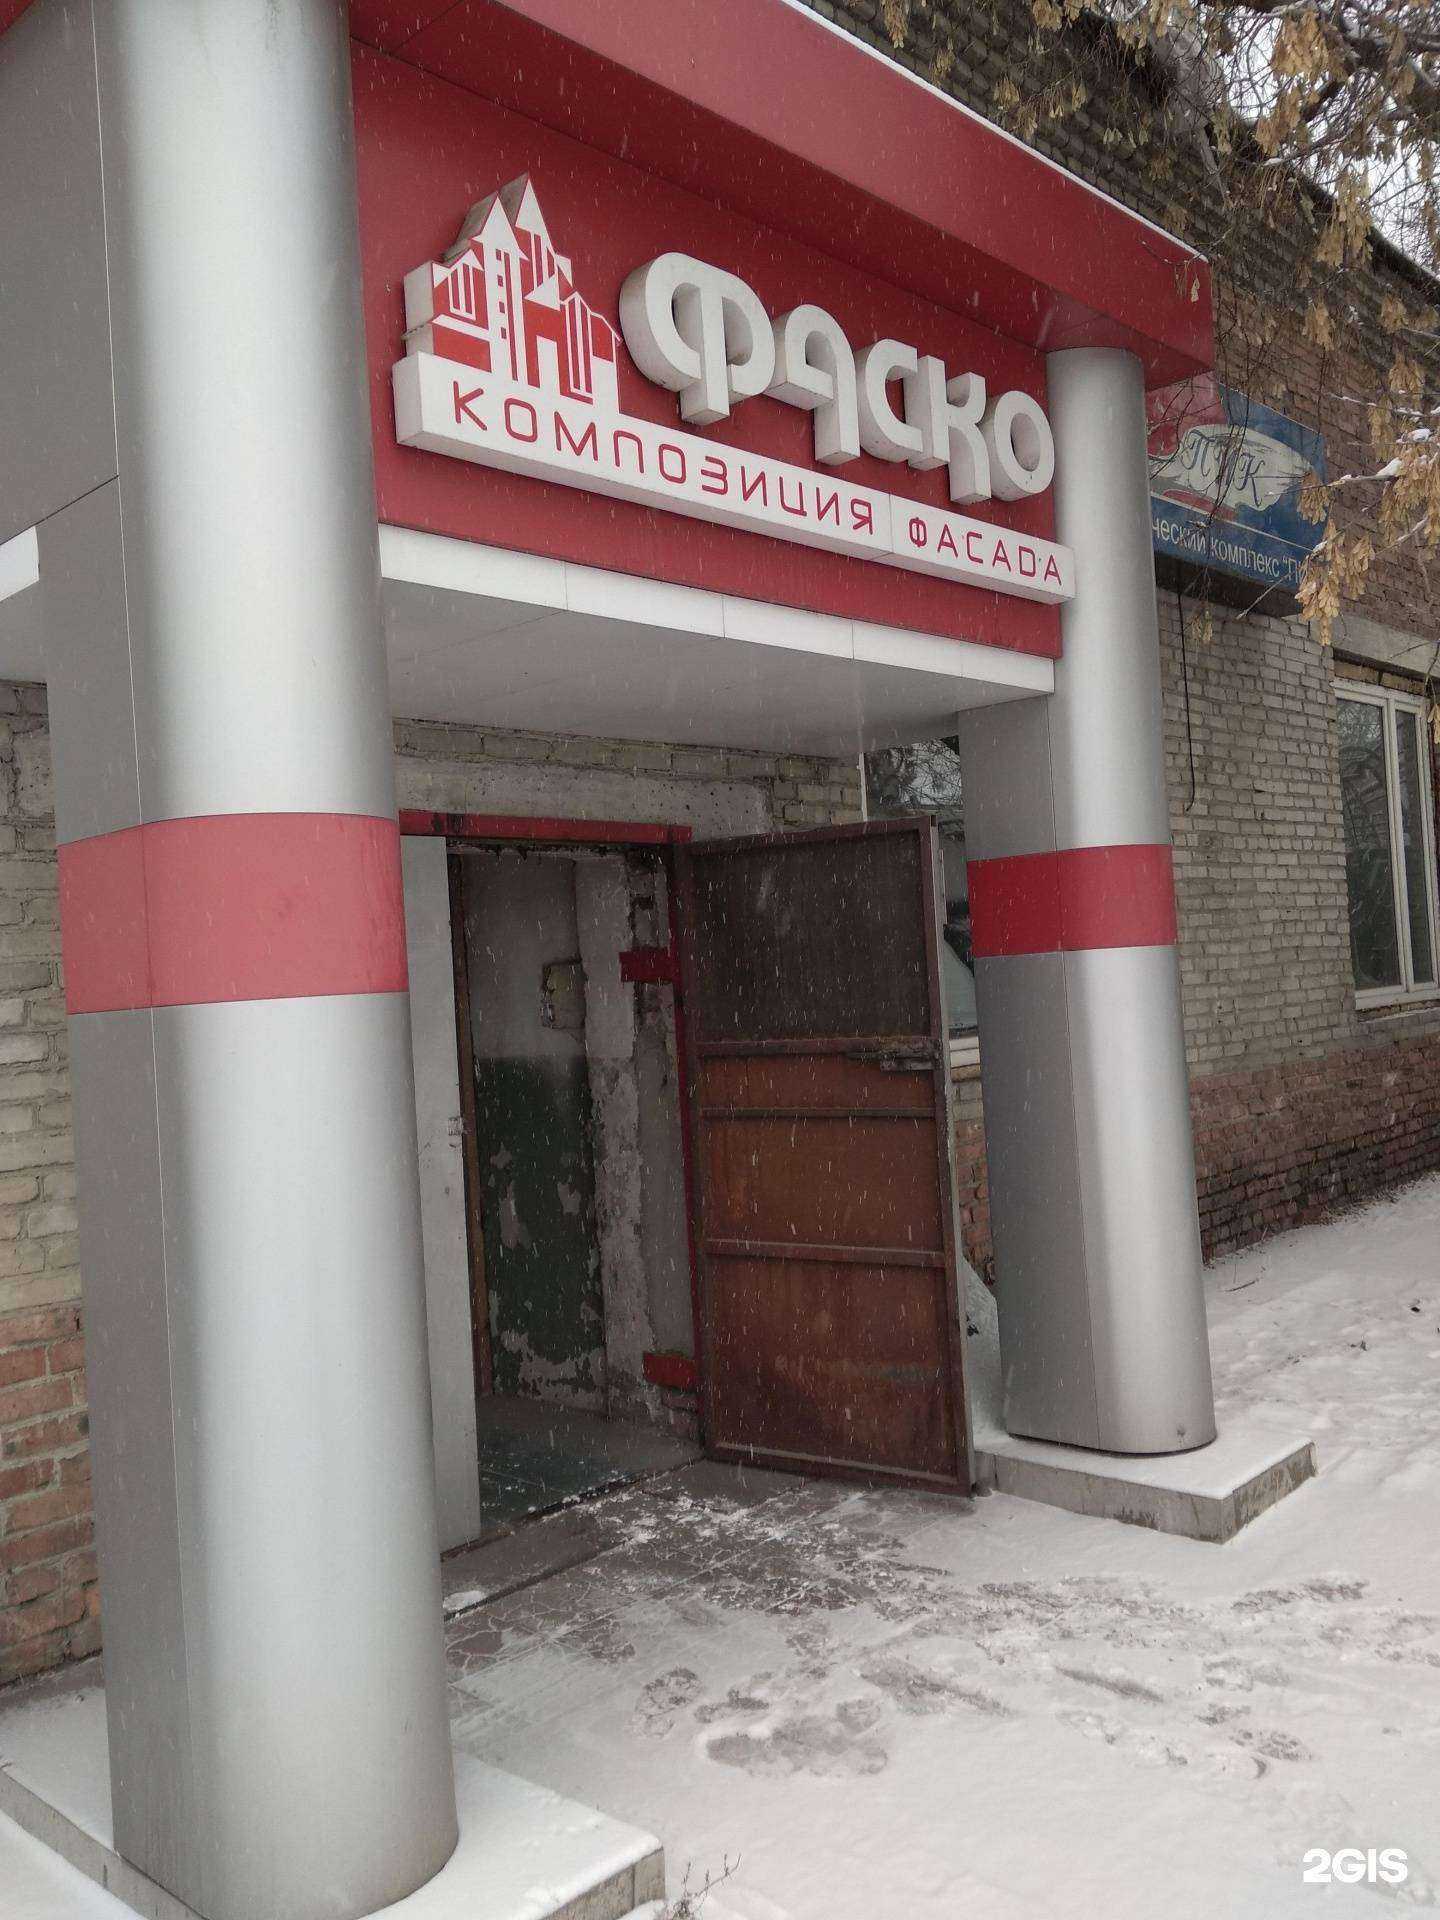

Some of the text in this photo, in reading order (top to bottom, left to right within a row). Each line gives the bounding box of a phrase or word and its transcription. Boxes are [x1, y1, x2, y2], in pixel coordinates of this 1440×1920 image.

[620, 252, 1055, 504] ФАСКО
[453, 380, 1063, 588] КОМПОЗИЦИЯ ФАСАДА
[1210, 536, 1280, 578] комплекс
